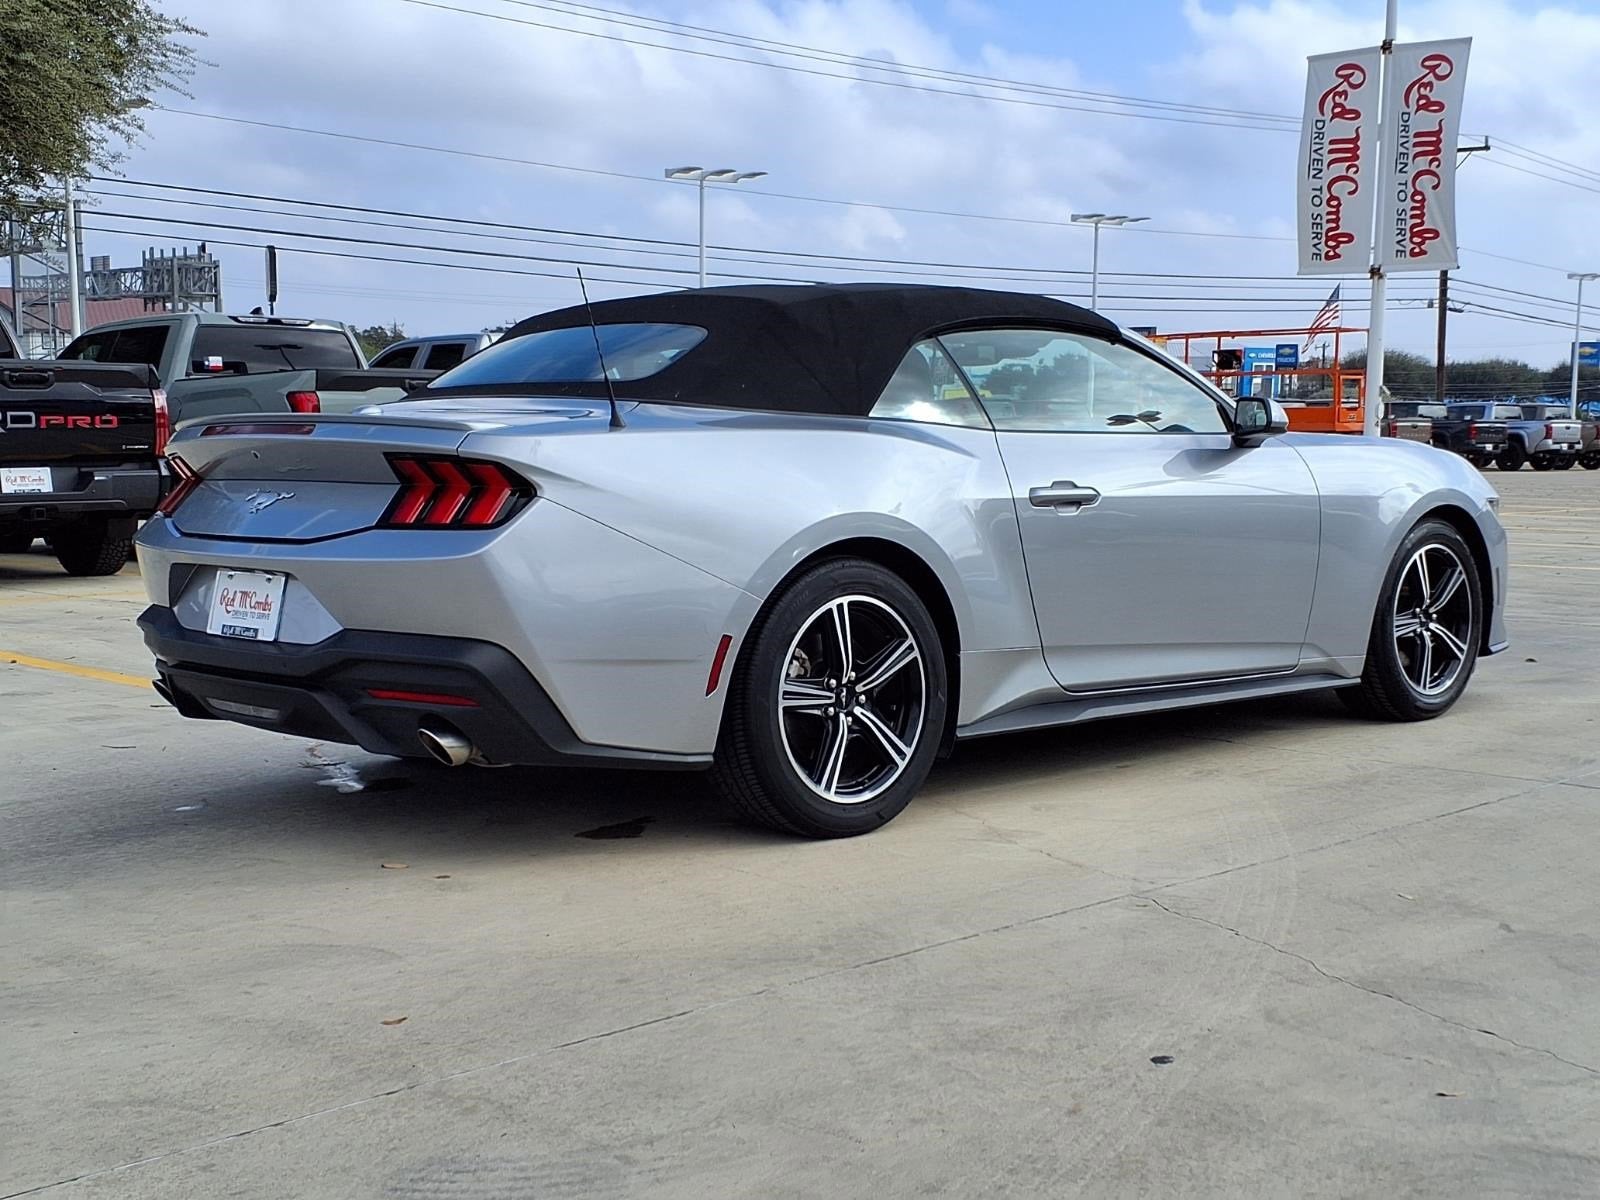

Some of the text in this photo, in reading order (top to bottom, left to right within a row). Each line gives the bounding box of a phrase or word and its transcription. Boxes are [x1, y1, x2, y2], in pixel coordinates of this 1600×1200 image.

[1319, 63, 1367, 123] Red
[1404, 54, 1453, 115] Red
[1311, 119, 1326, 262] DRIVEN TO SERVE
[1395, 112, 1411, 259] DRIVEN TO SERVE
[40, 414, 119, 429] PRO
[220, 587, 238, 614] Red
